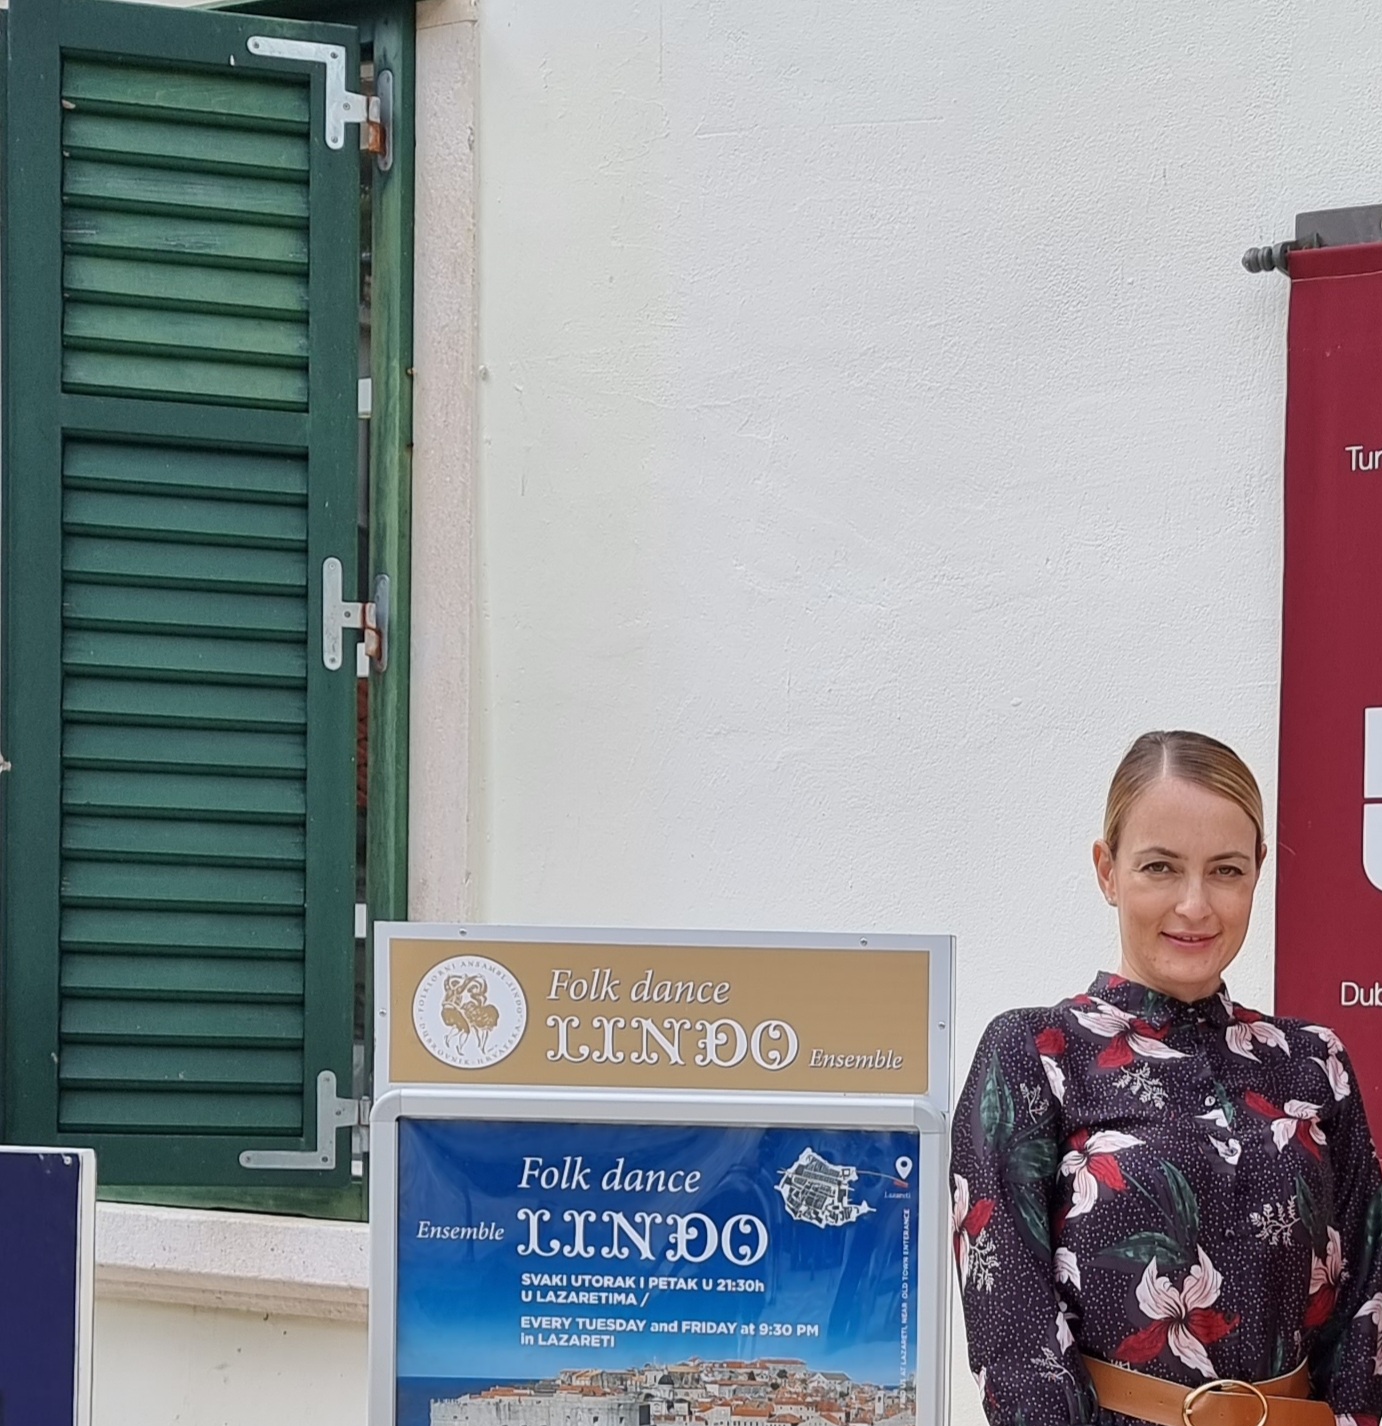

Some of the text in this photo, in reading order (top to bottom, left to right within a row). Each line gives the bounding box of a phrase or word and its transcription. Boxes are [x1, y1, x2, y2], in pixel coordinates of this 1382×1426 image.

[547, 967, 731, 1003] Folk dance
[809, 1048, 904, 1070] Ensemble
[517, 1156, 701, 1193] Folk dance
[416, 1220, 505, 1241] Ensemble
[902, 1256, 910, 1280] TOWN
[521, 1273, 765, 1293] SVAKI UTORAK I PETAK U 21:30h
[901, 1282, 909, 1300] OLD
[521, 1290, 532, 1302] U
[536, 1290, 638, 1306] LAZARETIMA
[521, 1316, 819, 1337] EVERY TUESDAY and FRIDAY at 9:30 PM
[521, 1332, 615, 1348] in LAZARETI
